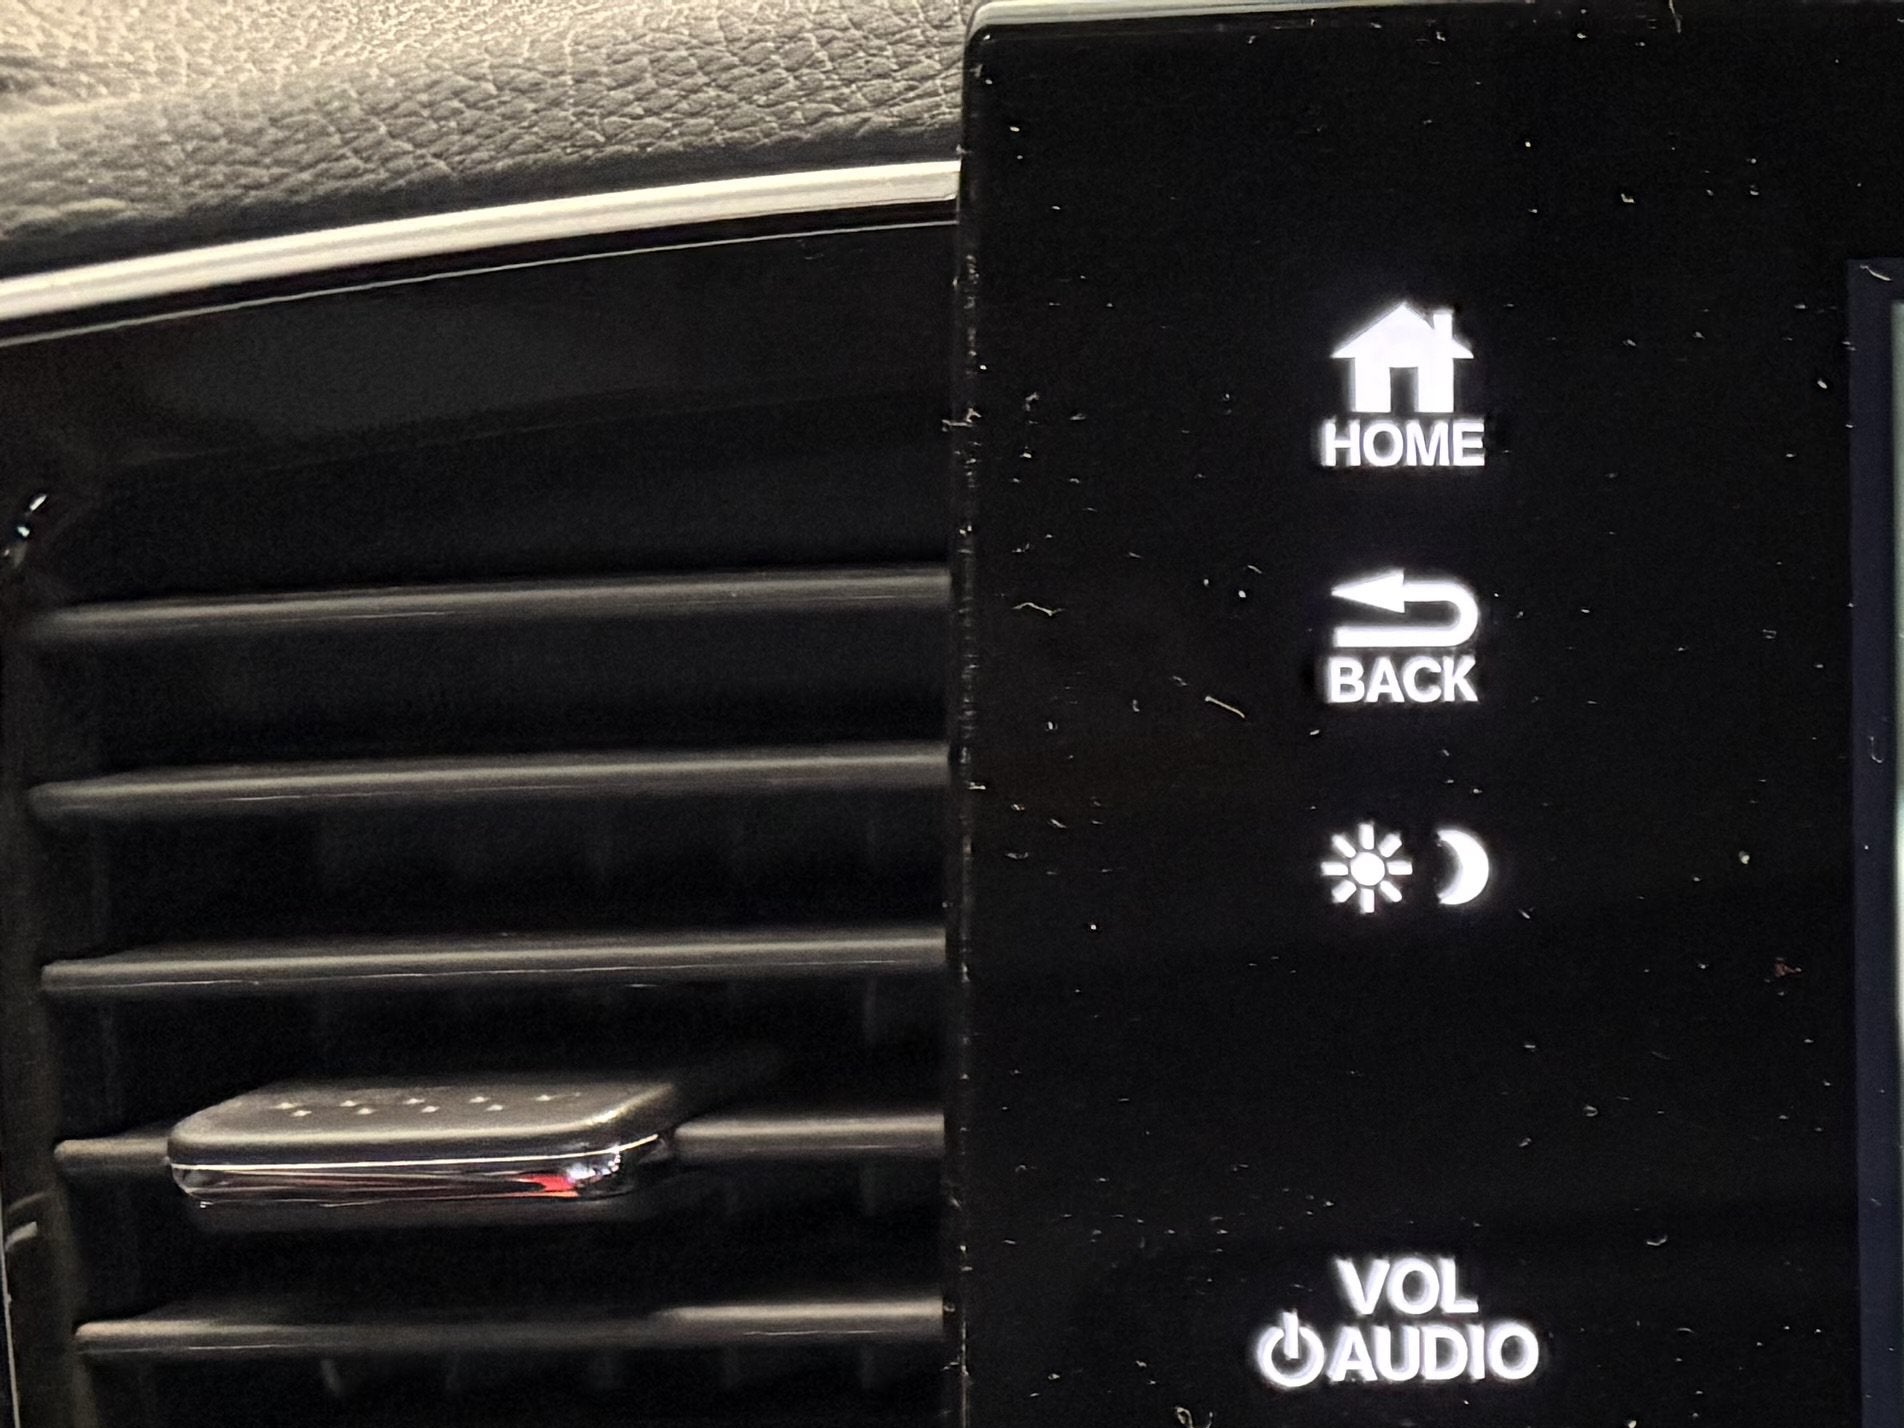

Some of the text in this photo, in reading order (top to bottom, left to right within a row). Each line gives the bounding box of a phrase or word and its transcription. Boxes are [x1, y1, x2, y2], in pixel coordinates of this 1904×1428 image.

[1320, 417, 1486, 468] HOME
[1325, 653, 1479, 705] BACK
[1334, 1255, 1481, 1318] VOL
[1326, 1322, 1541, 1383] AUDIO
